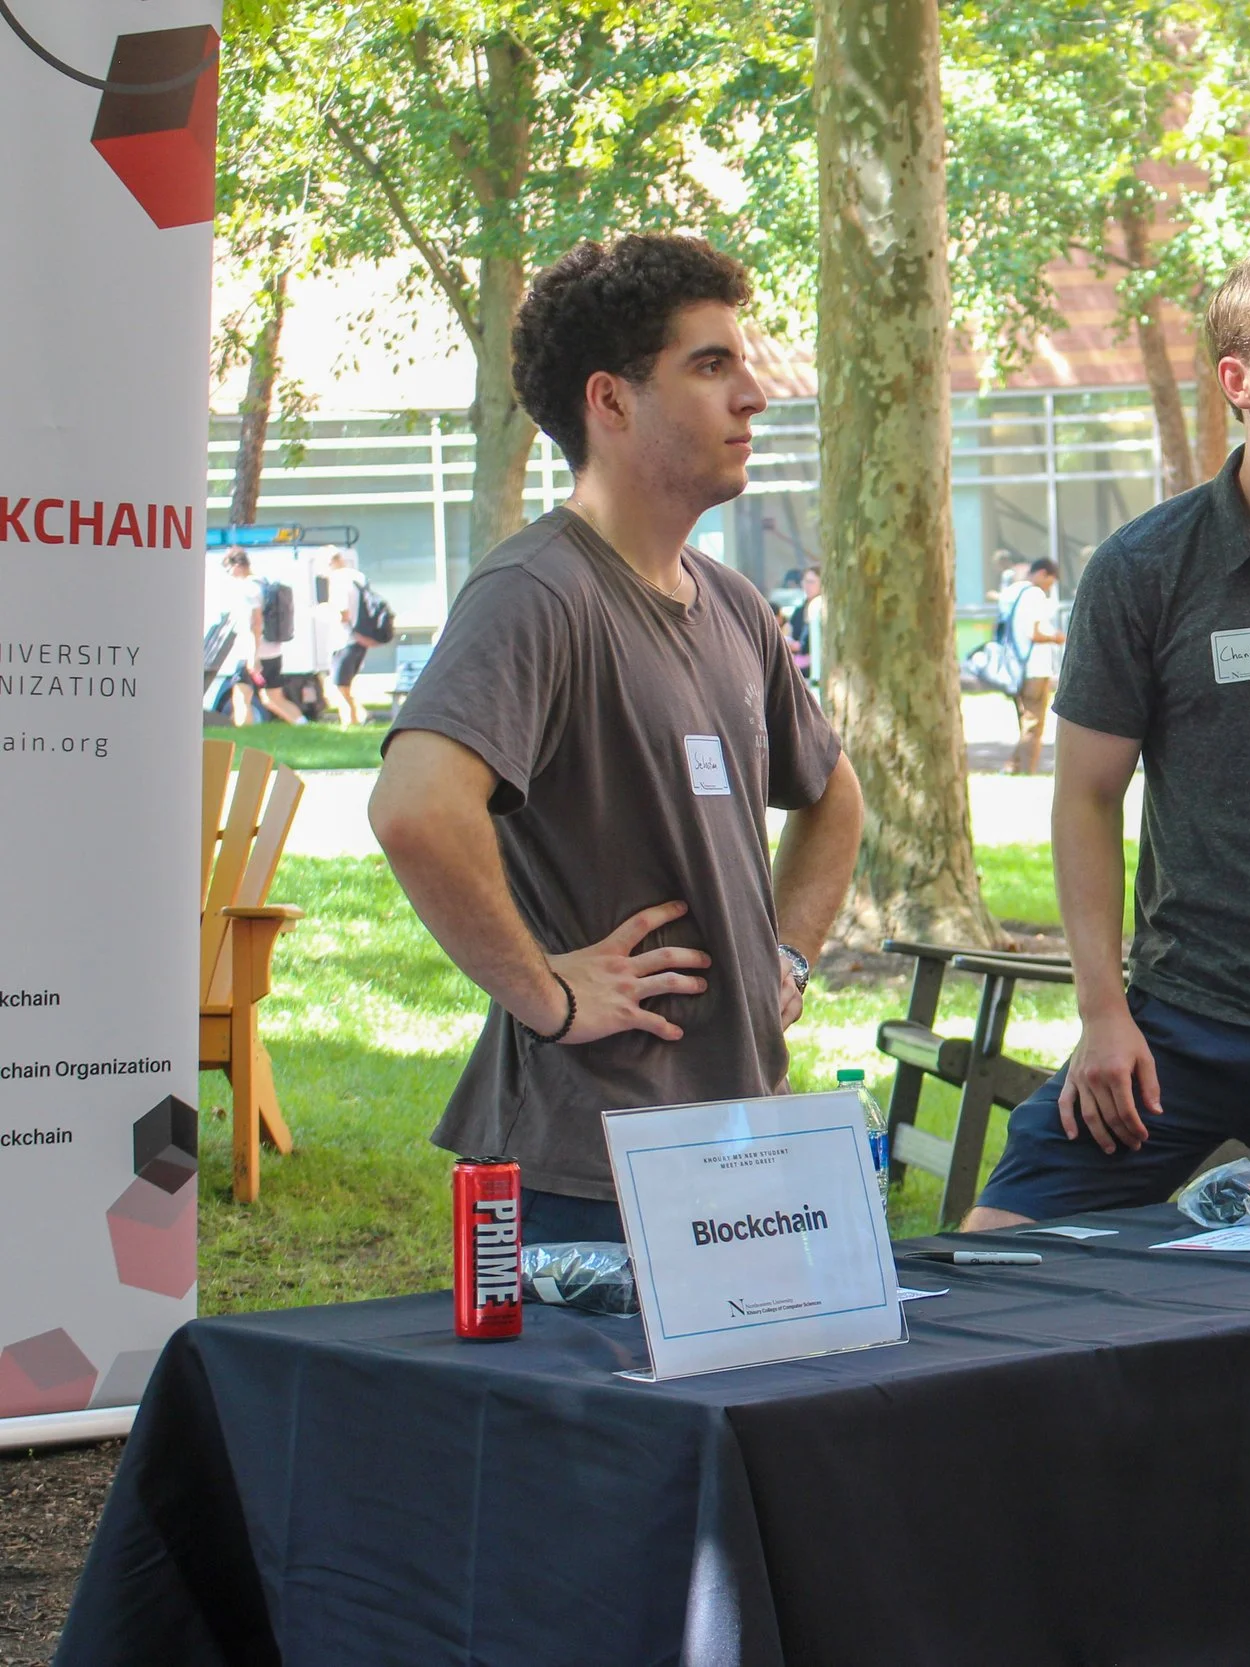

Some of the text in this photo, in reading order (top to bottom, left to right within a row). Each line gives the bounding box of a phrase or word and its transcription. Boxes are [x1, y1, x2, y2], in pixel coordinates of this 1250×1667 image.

[0, 497, 192, 549] KCHAIN
[0, 643, 140, 666] IVERSITY
[0, 675, 137, 698] NIZATION
[3, 732, 109, 757] ain.org
[0, 990, 60, 1007] kchain
[0, 1057, 171, 1080] chain Organization
[0, 1128, 72, 1146] ckchain
[720, 1161, 738, 1169] MEET
[756, 1158, 775, 1166] GREET
[759, 1148, 789, 1157] STUDENT
[691, 1204, 828, 1246] Blockchain
[476, 1199, 519, 1306] PRIME
[728, 1298, 745, 1317] N
[783, 1303, 803, 1311] Computer
